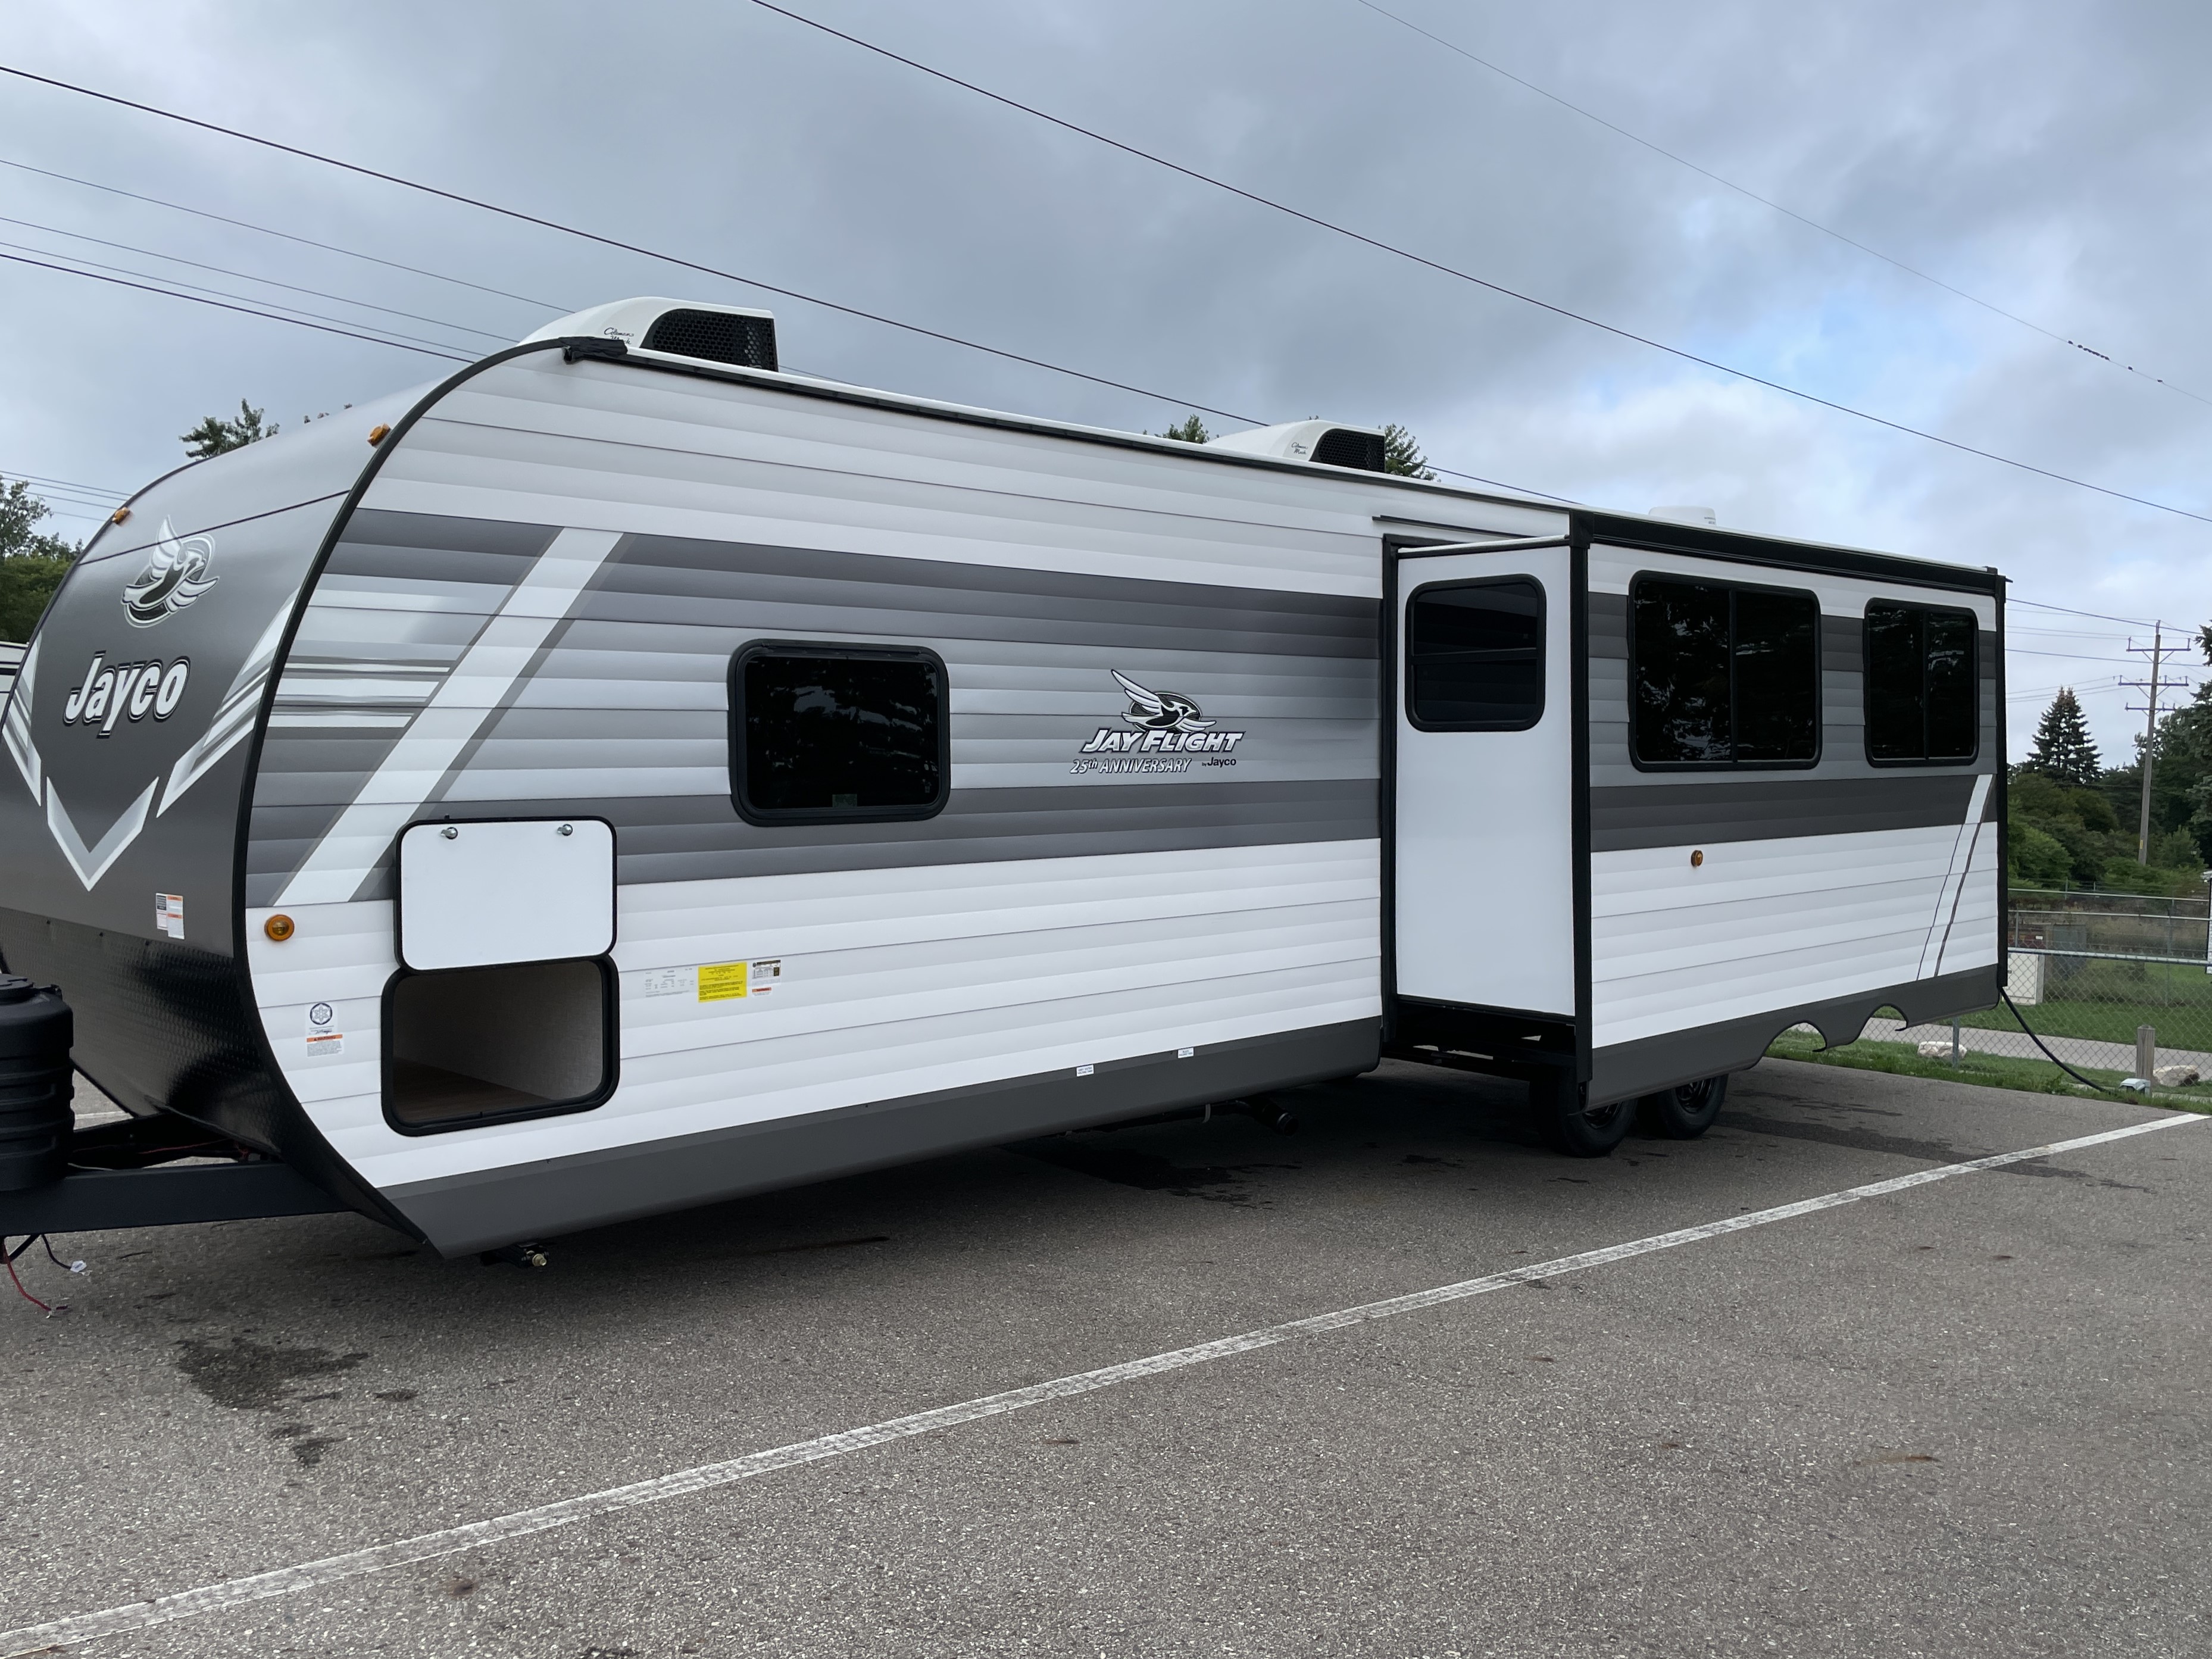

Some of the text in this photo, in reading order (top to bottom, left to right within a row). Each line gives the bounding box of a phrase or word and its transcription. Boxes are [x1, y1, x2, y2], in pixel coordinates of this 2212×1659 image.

[63, 650, 191, 739] Jayco
[1079, 727, 1246, 754] JAY FLIGHT
[1070, 757, 1192, 774] 25th ANNIVERSARY
[1207, 757, 1237, 768] Jayco
